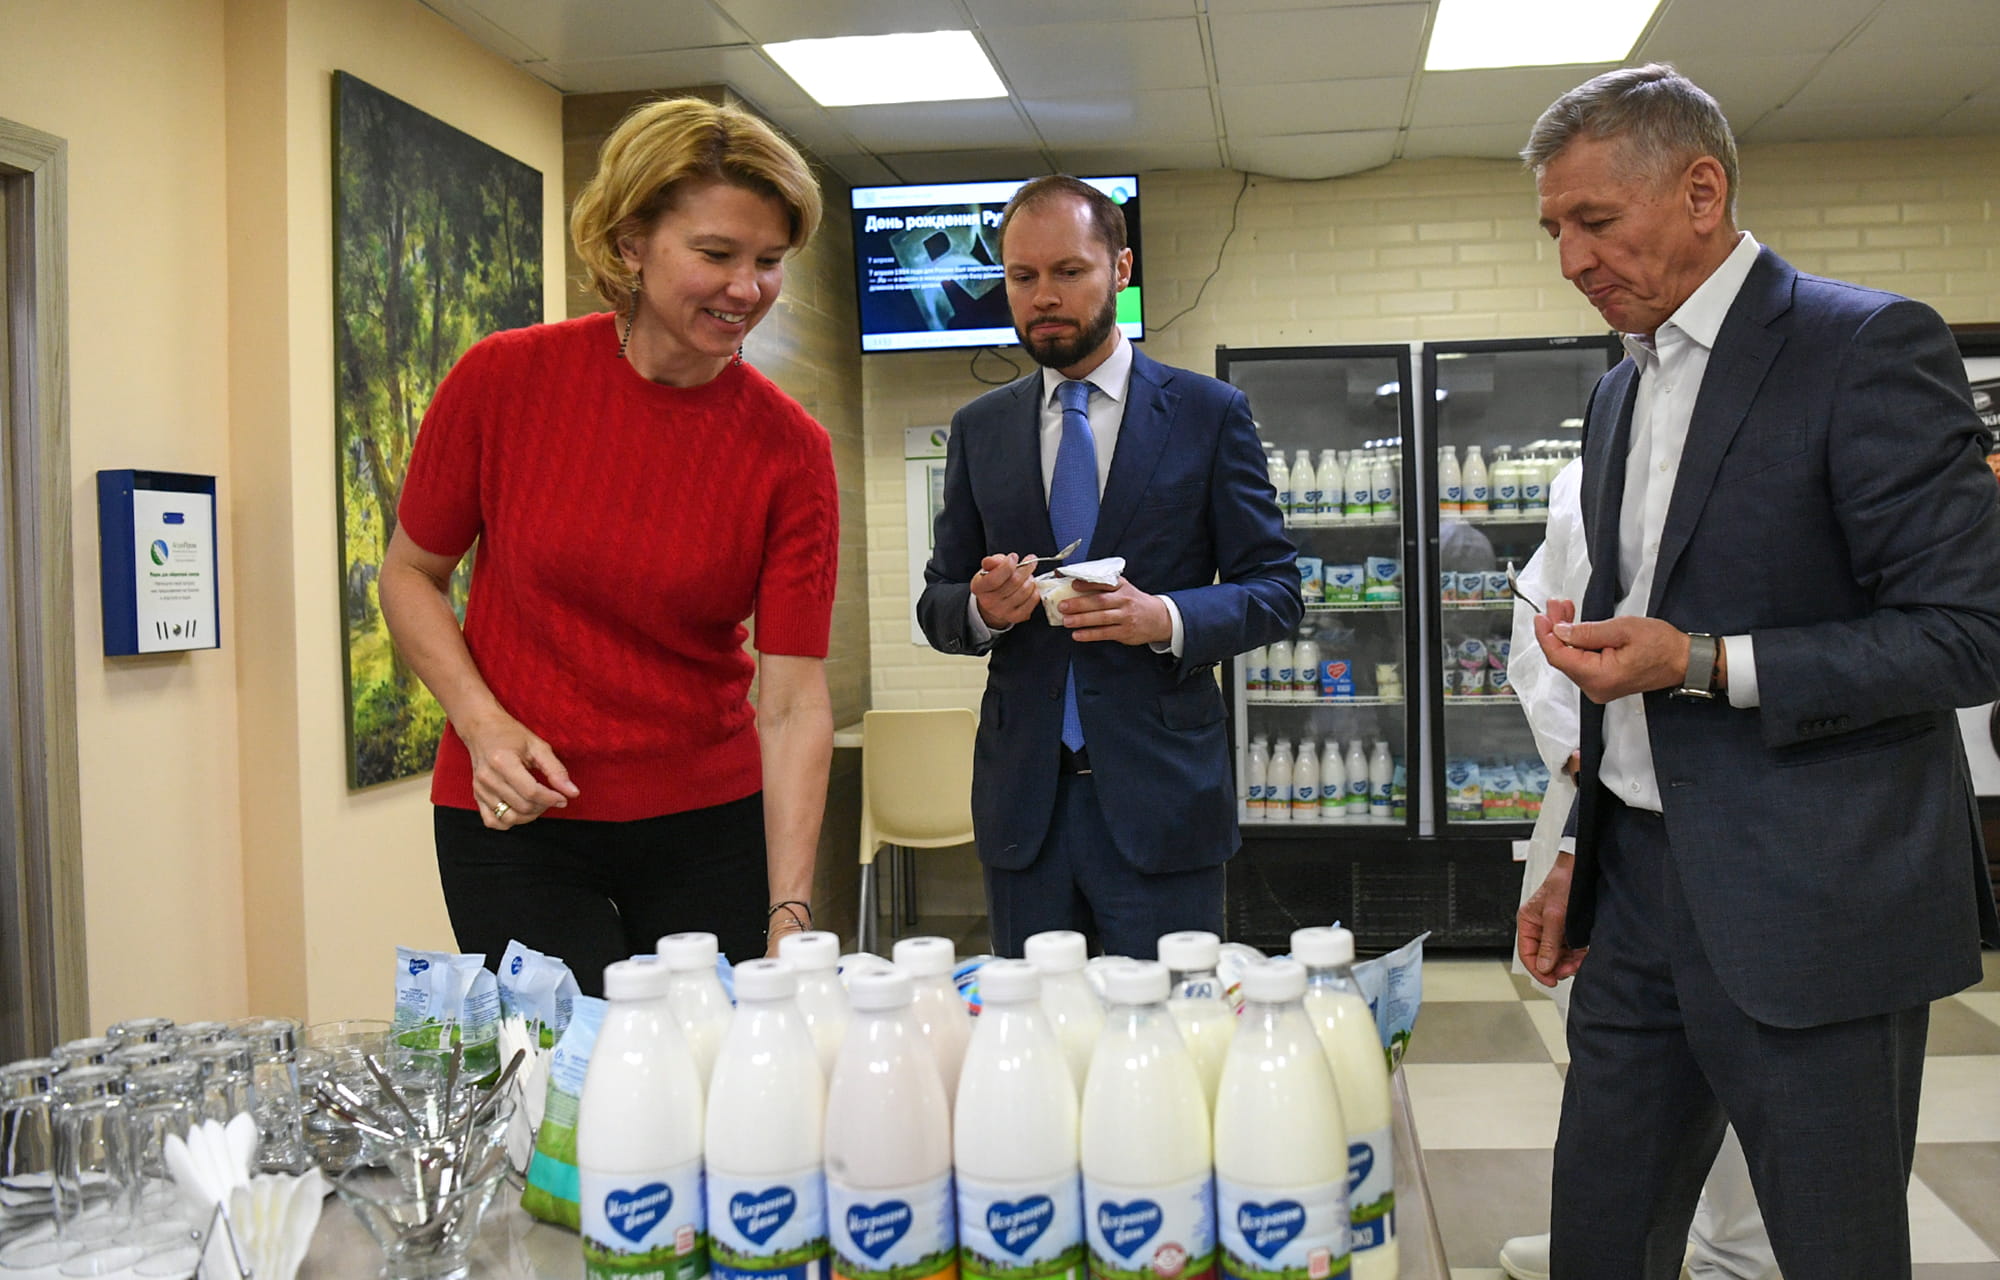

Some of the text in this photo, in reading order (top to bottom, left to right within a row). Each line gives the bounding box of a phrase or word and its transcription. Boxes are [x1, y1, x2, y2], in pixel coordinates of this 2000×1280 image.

[865, 210, 1004, 232] День рождения Ру
